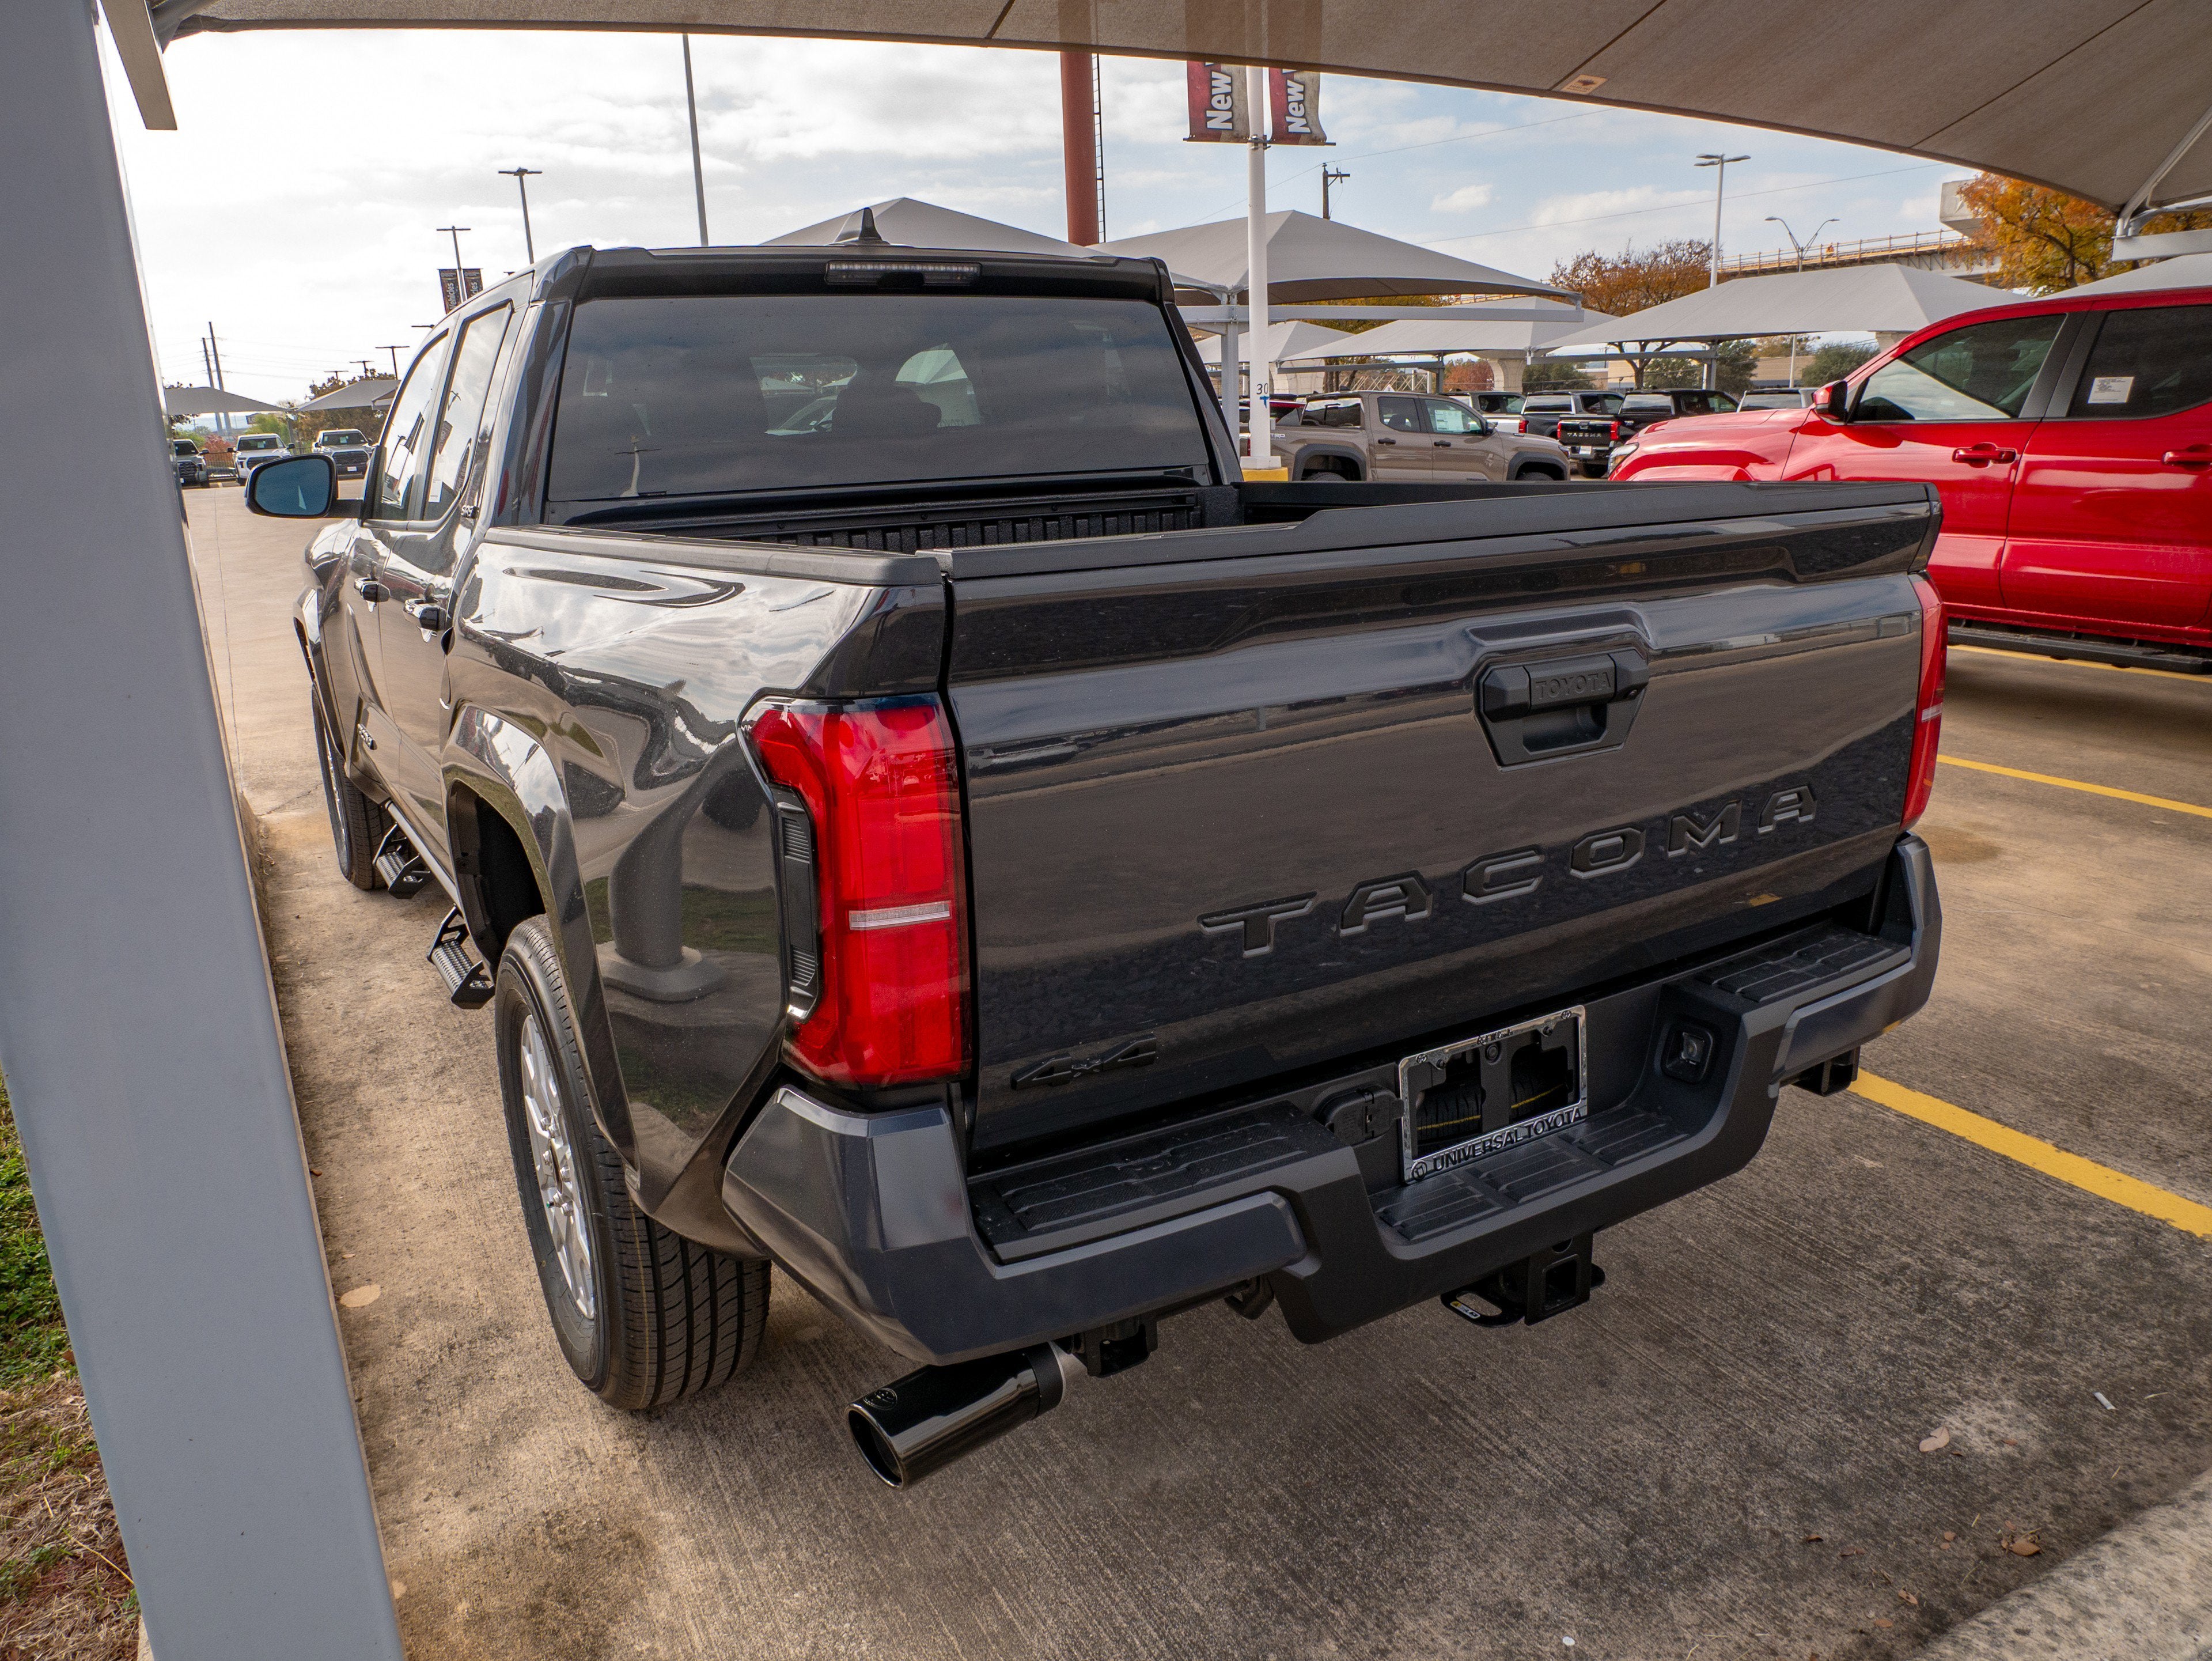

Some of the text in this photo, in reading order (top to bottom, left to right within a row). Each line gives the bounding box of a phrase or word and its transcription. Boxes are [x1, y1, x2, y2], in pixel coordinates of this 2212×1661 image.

[1206, 71, 1233, 130] New
[1285, 80, 1312, 134] New
[1256, 383, 1269, 395] 30
[1535, 672, 1612, 701] TOYOTA
[1196, 783, 1820, 959] TACOMA
[1432, 1128, 1523, 1171] UNIVERSAL
[1523, 1108, 1583, 1139] TOYOTA
